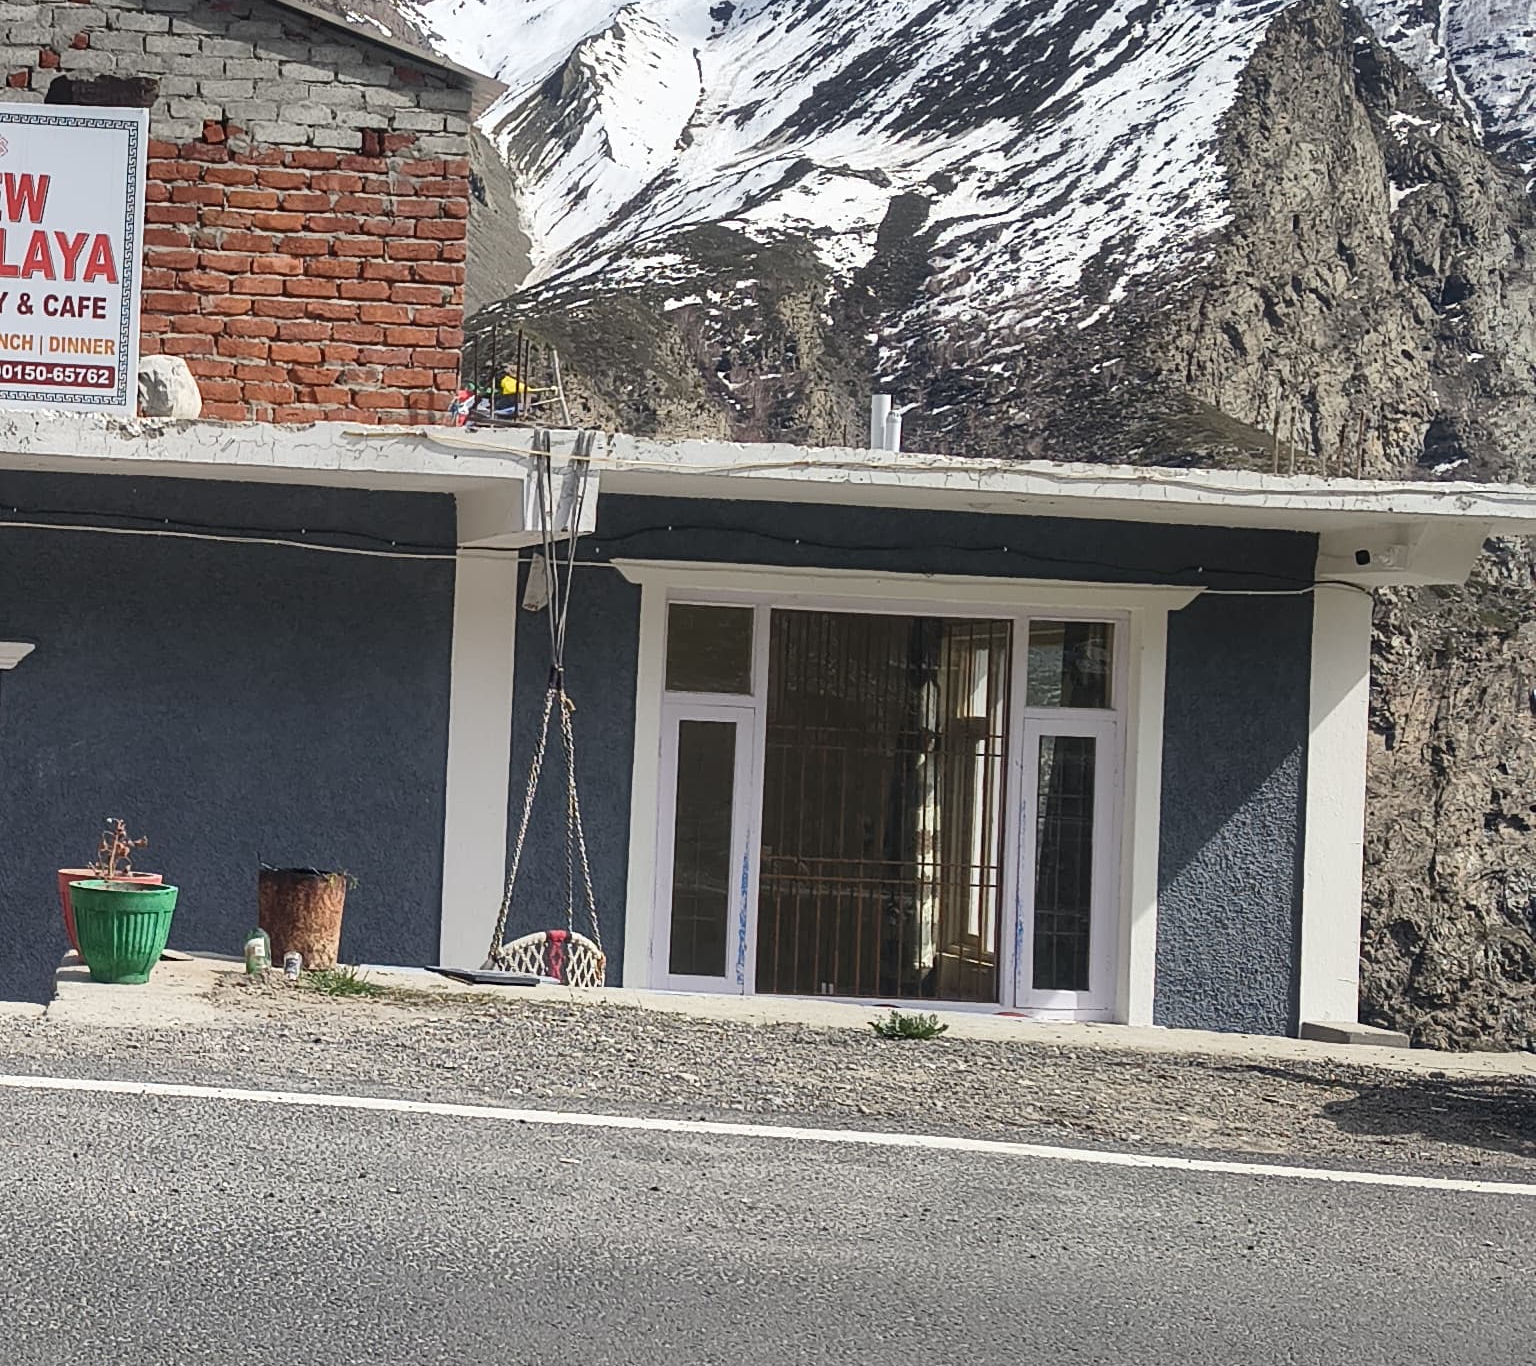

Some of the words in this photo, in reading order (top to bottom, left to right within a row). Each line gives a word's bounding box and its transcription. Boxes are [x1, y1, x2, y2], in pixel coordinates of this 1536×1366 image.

[17, 292, 34, 315] &
[43, 295, 107, 319] CAFE
[48, 336, 115, 355] DINNER
